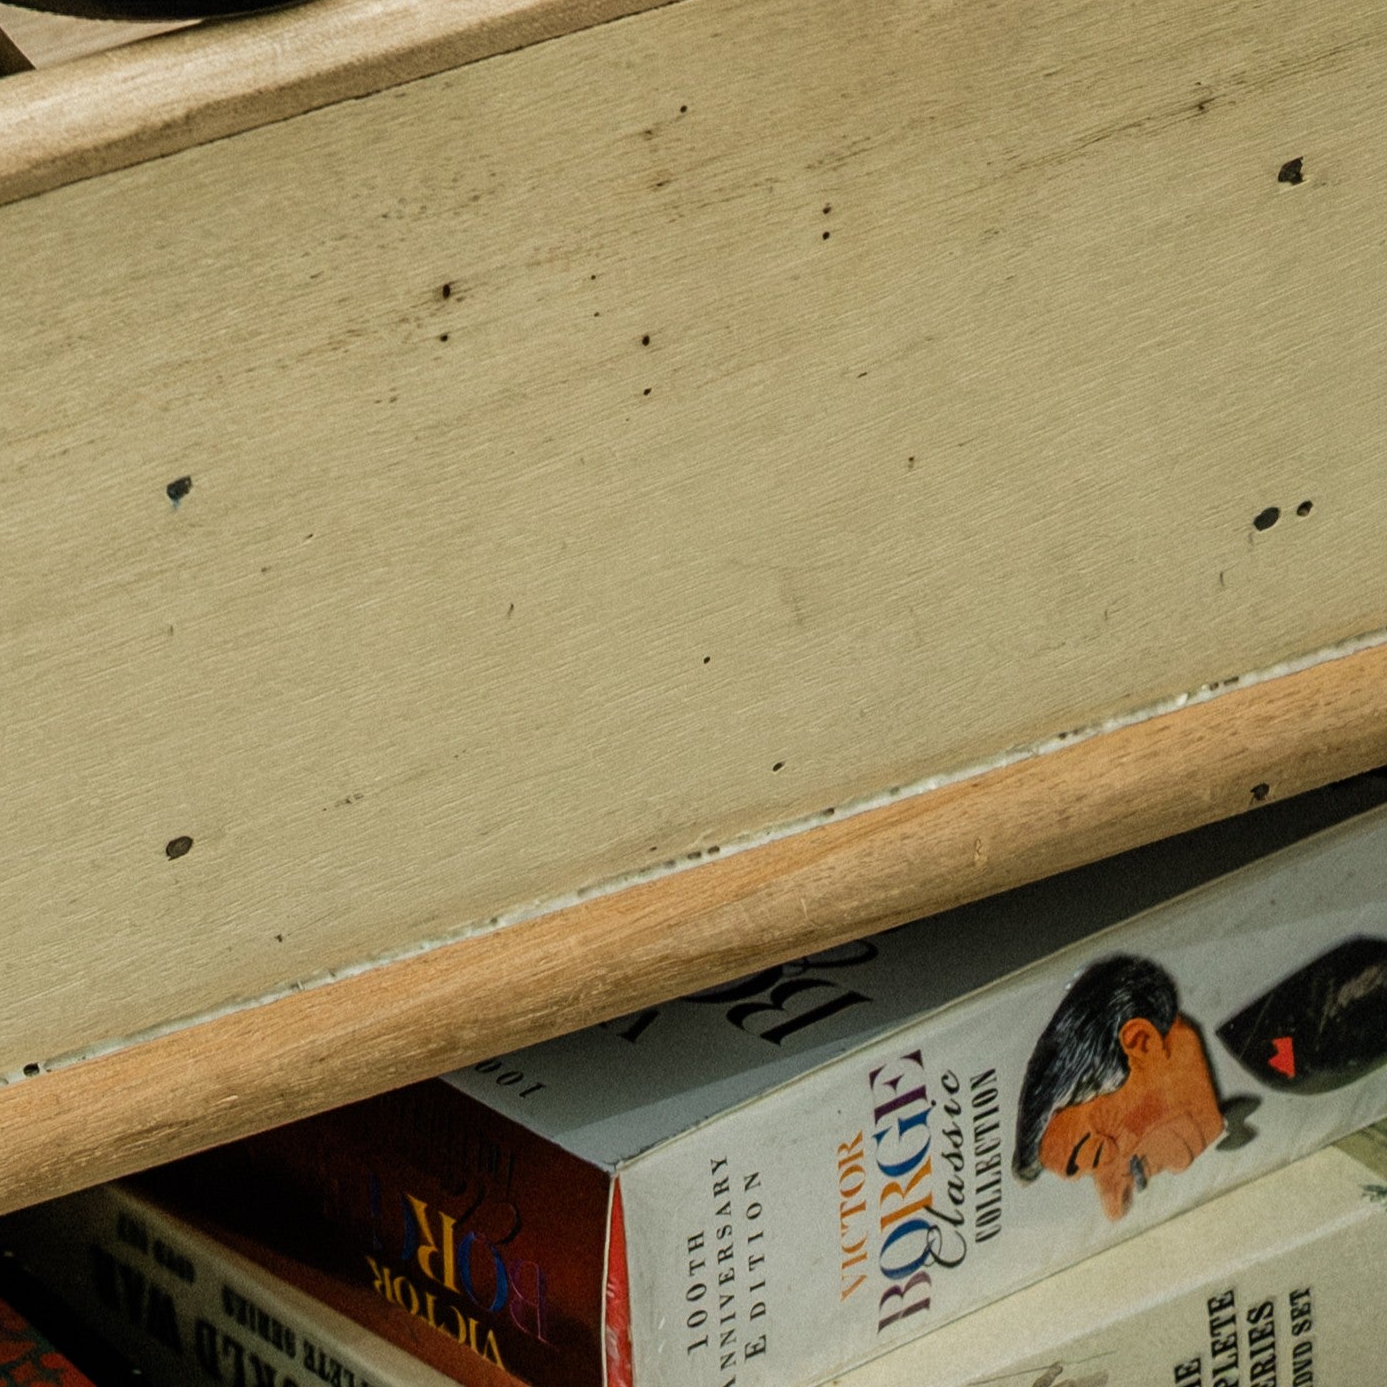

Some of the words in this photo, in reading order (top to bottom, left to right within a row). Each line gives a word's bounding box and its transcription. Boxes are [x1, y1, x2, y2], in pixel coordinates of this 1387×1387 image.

[836, 1130, 868, 1303] VICTOR
[868, 1049, 935, 1335] BORGE
[925, 1068, 968, 1269] Classic
[970, 1067, 1003, 1244] COLLECTION
[686, 1229, 709, 1357] 100TH
[744, 1170, 768, 1361] EDITION
[1288, 1286, 1314, 1337] SET
